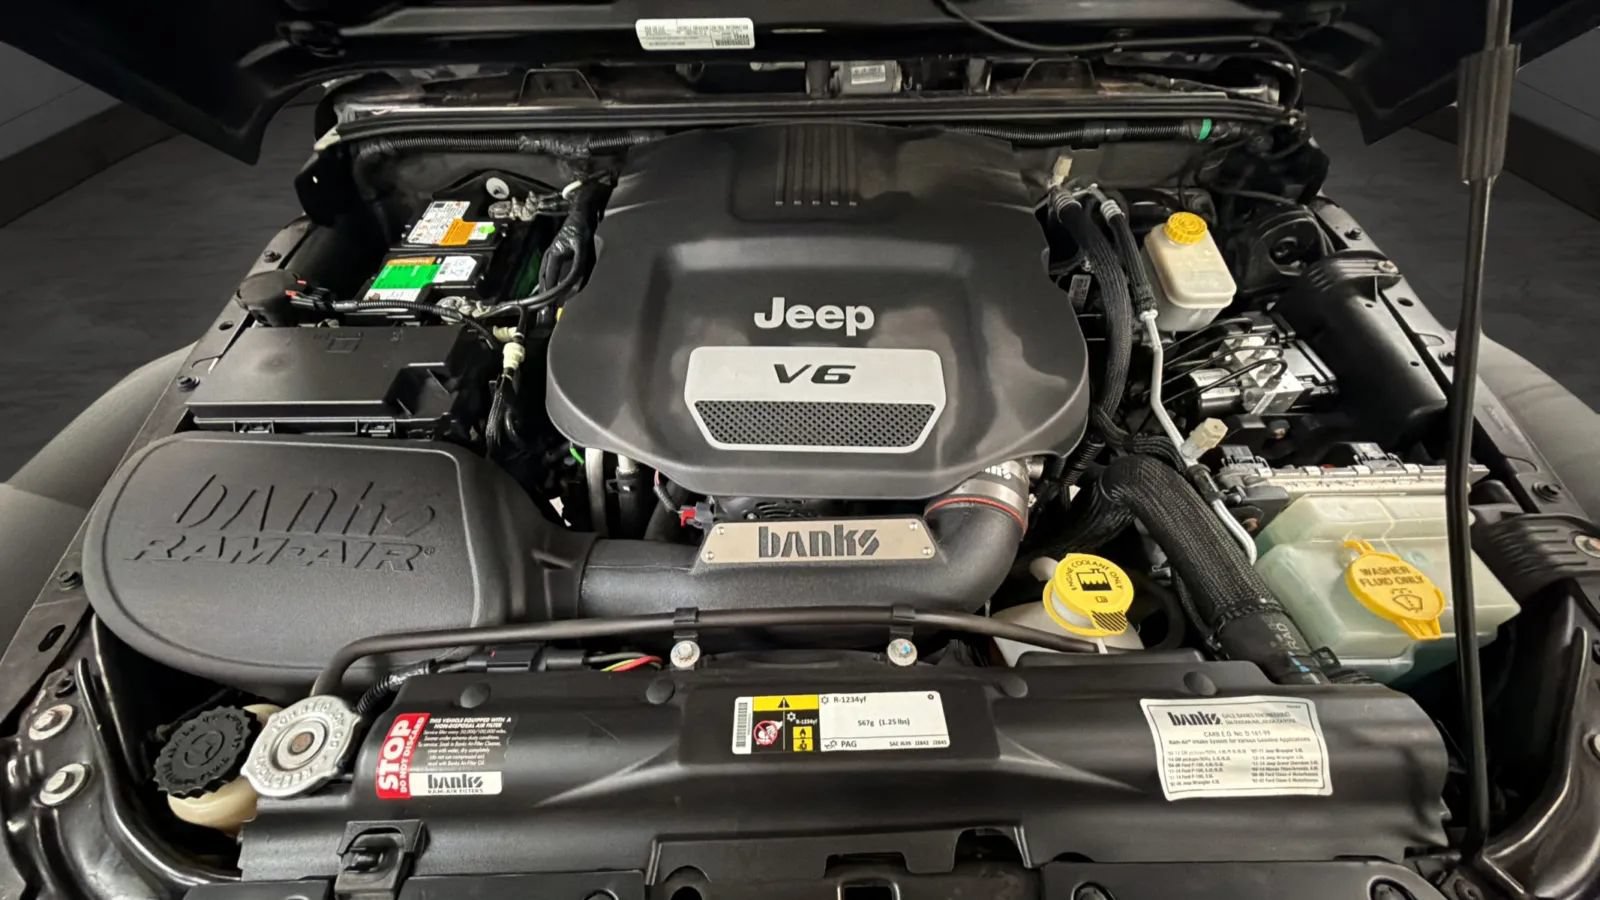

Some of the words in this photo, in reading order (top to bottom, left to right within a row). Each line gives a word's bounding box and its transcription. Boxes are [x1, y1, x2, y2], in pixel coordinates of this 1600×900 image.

[754, 297, 875, 336] Jeep
[774, 364, 856, 384] V6
[758, 524, 880, 558] banks
[1072, 560, 1110, 570] COOLANT
[1110, 571, 1123, 590] ONLY
[1360, 566, 1410, 576] WASHER
[1360, 577, 1394, 587] FLUID
[1394, 575, 1424, 585] ONLY
[834, 696, 866, 704] R-1234yf
[858, 720, 874, 728] 567g
[878, 719, 896, 727] (1.25
[897, 718, 910, 726] lbs)
[1168, 712, 1221, 726] banks
[405, 717, 425, 756] DISCARD
[840, 740, 857, 748] PAG
[379, 719, 411, 790] STOP
[400, 758, 409, 779] NOT
[400, 780, 408, 793] DO
[428, 774, 483, 788] banks
